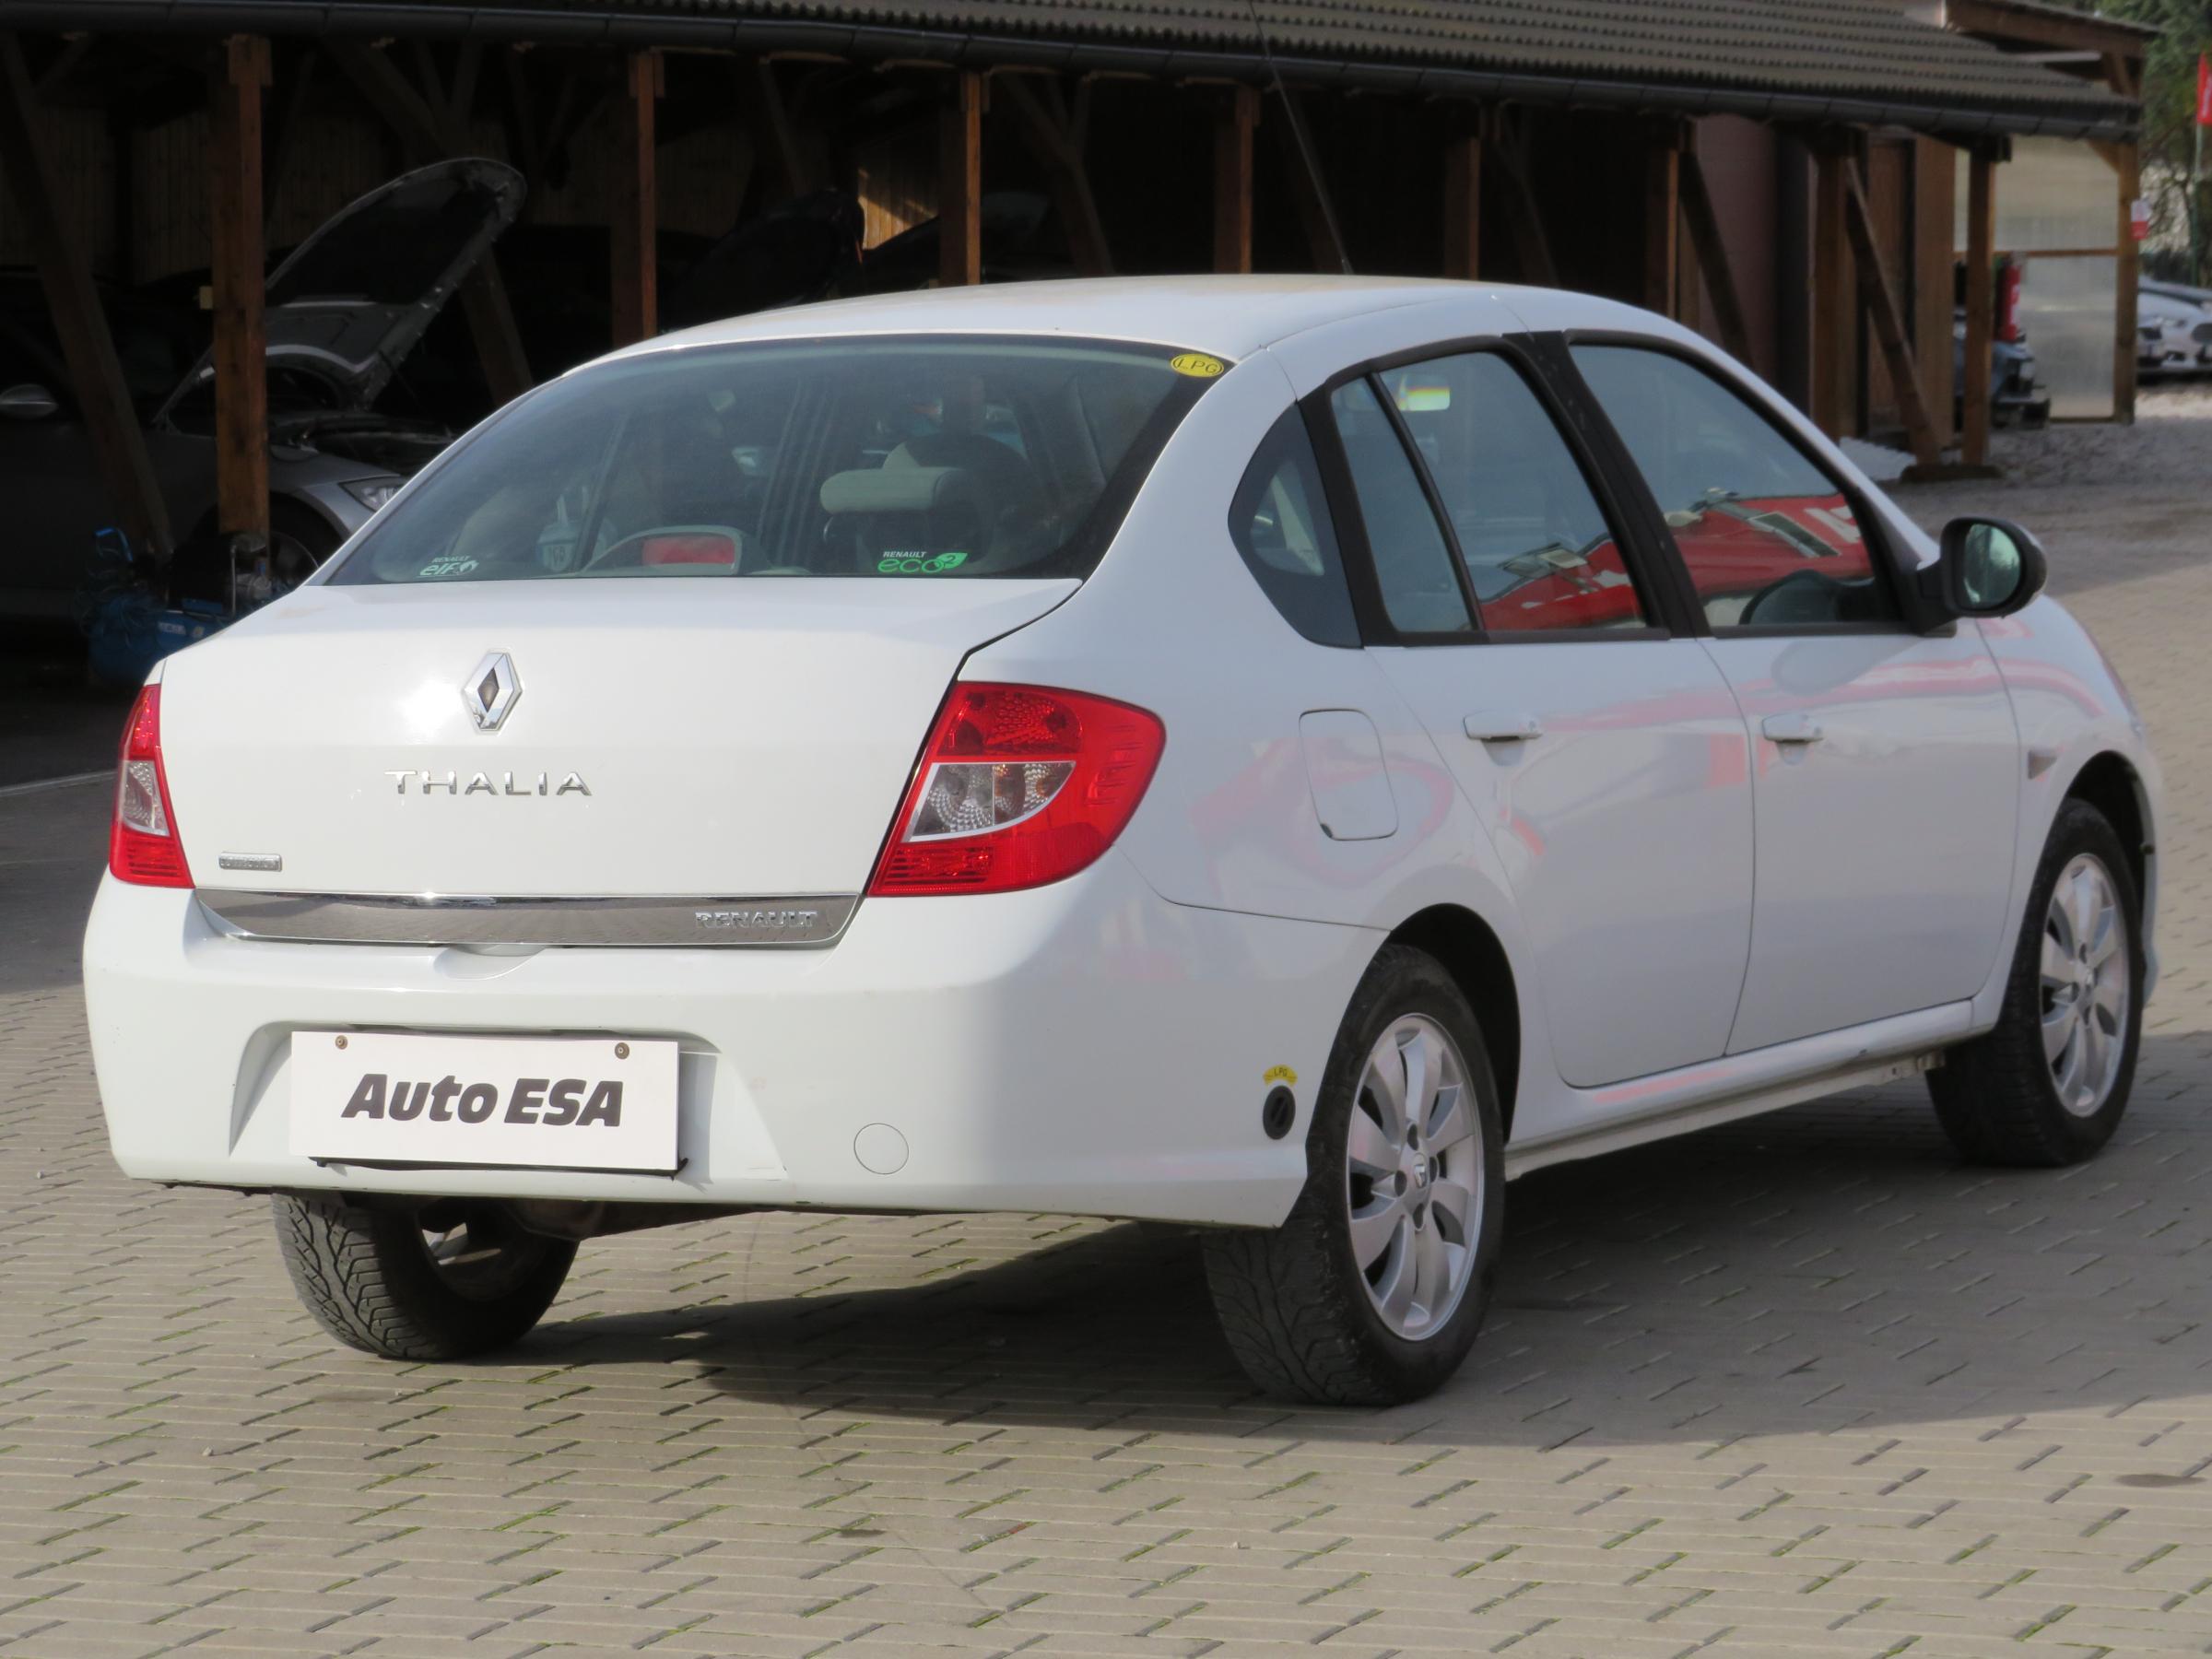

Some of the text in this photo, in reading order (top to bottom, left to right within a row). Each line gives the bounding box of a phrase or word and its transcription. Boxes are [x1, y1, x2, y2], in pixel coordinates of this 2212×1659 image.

[1175, 358, 1218, 373] LPG
[420, 561, 461, 576] elf
[383, 770, 593, 796] THALIA
[694, 910, 818, 929] RENAULT
[340, 1073, 624, 1127] Auto ESA
